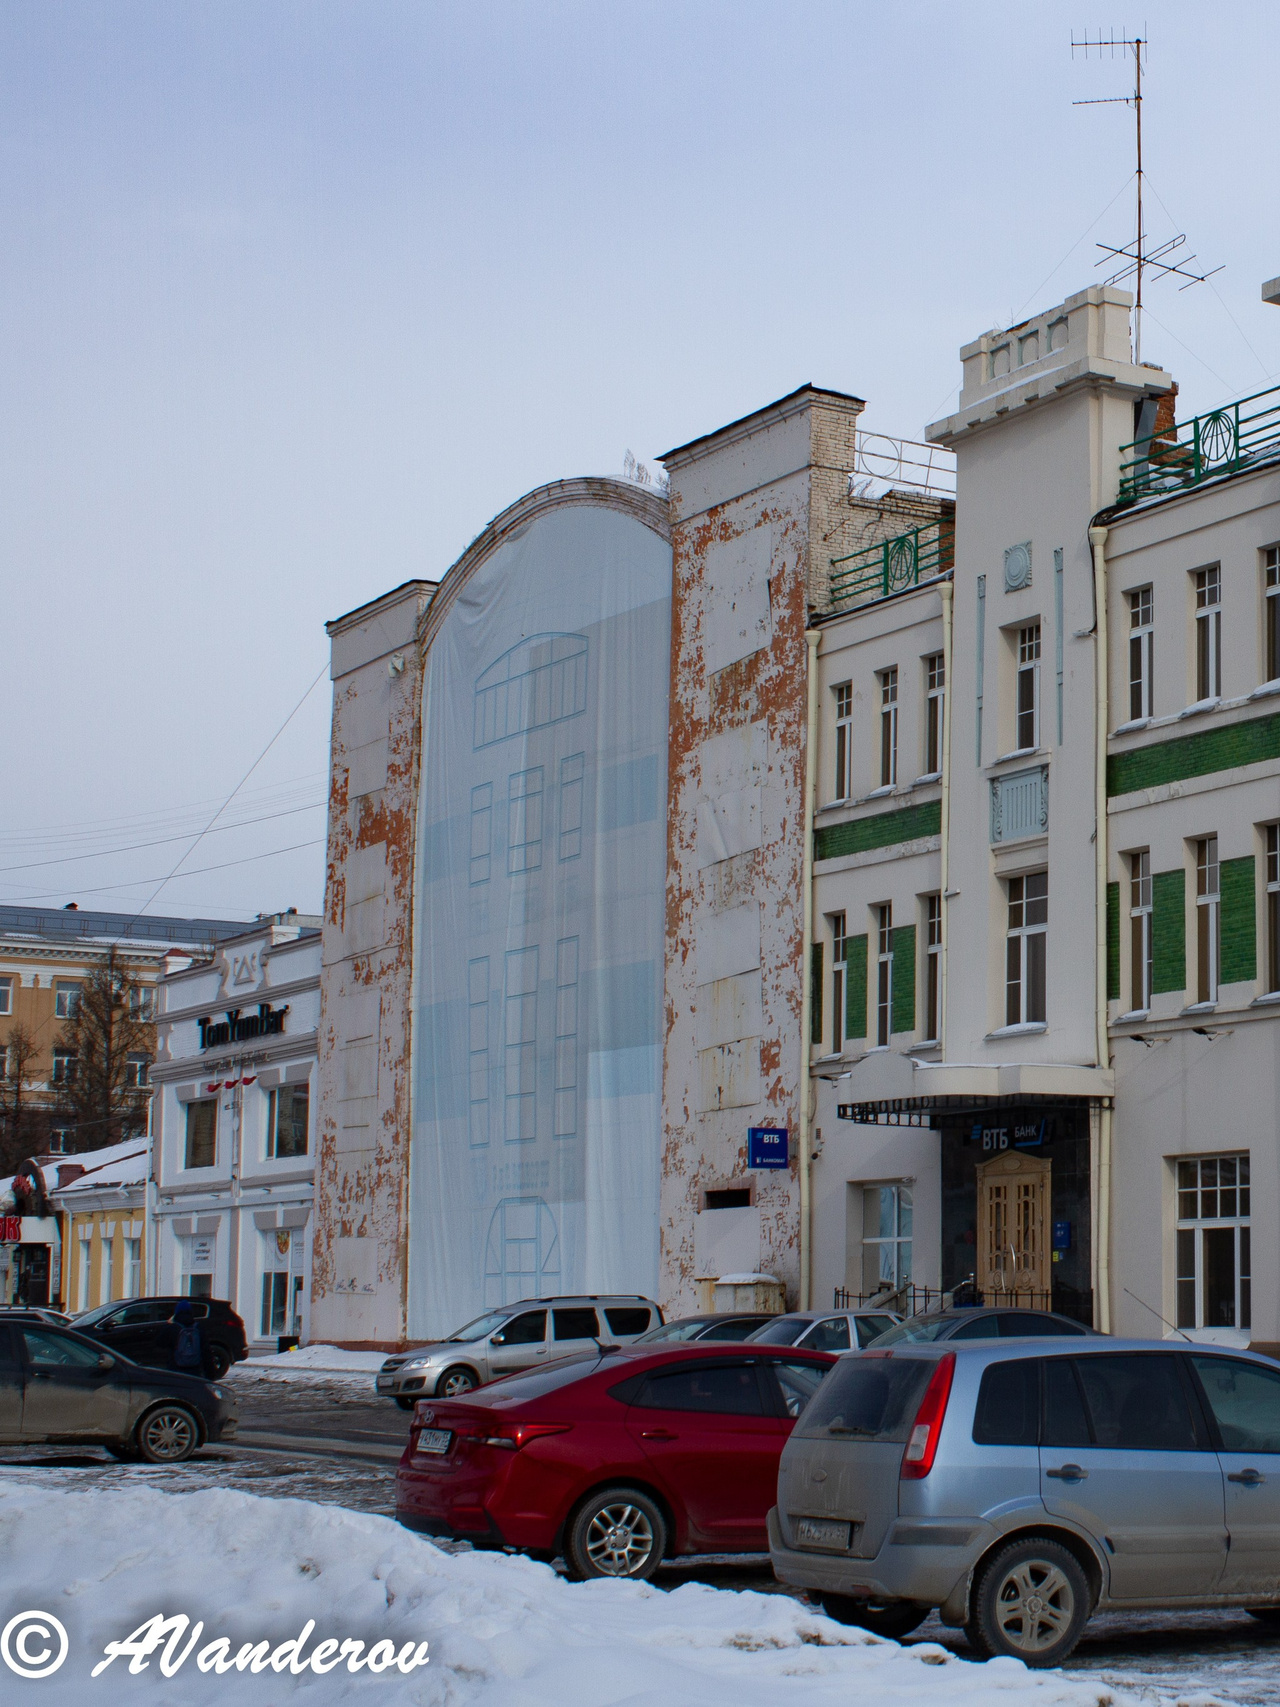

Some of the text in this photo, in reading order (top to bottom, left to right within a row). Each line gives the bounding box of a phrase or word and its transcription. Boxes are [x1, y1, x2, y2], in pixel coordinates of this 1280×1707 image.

[763, 1134, 780, 1144] ВТБ
[983, 1125, 1037, 1150] ВТБ БАНК
